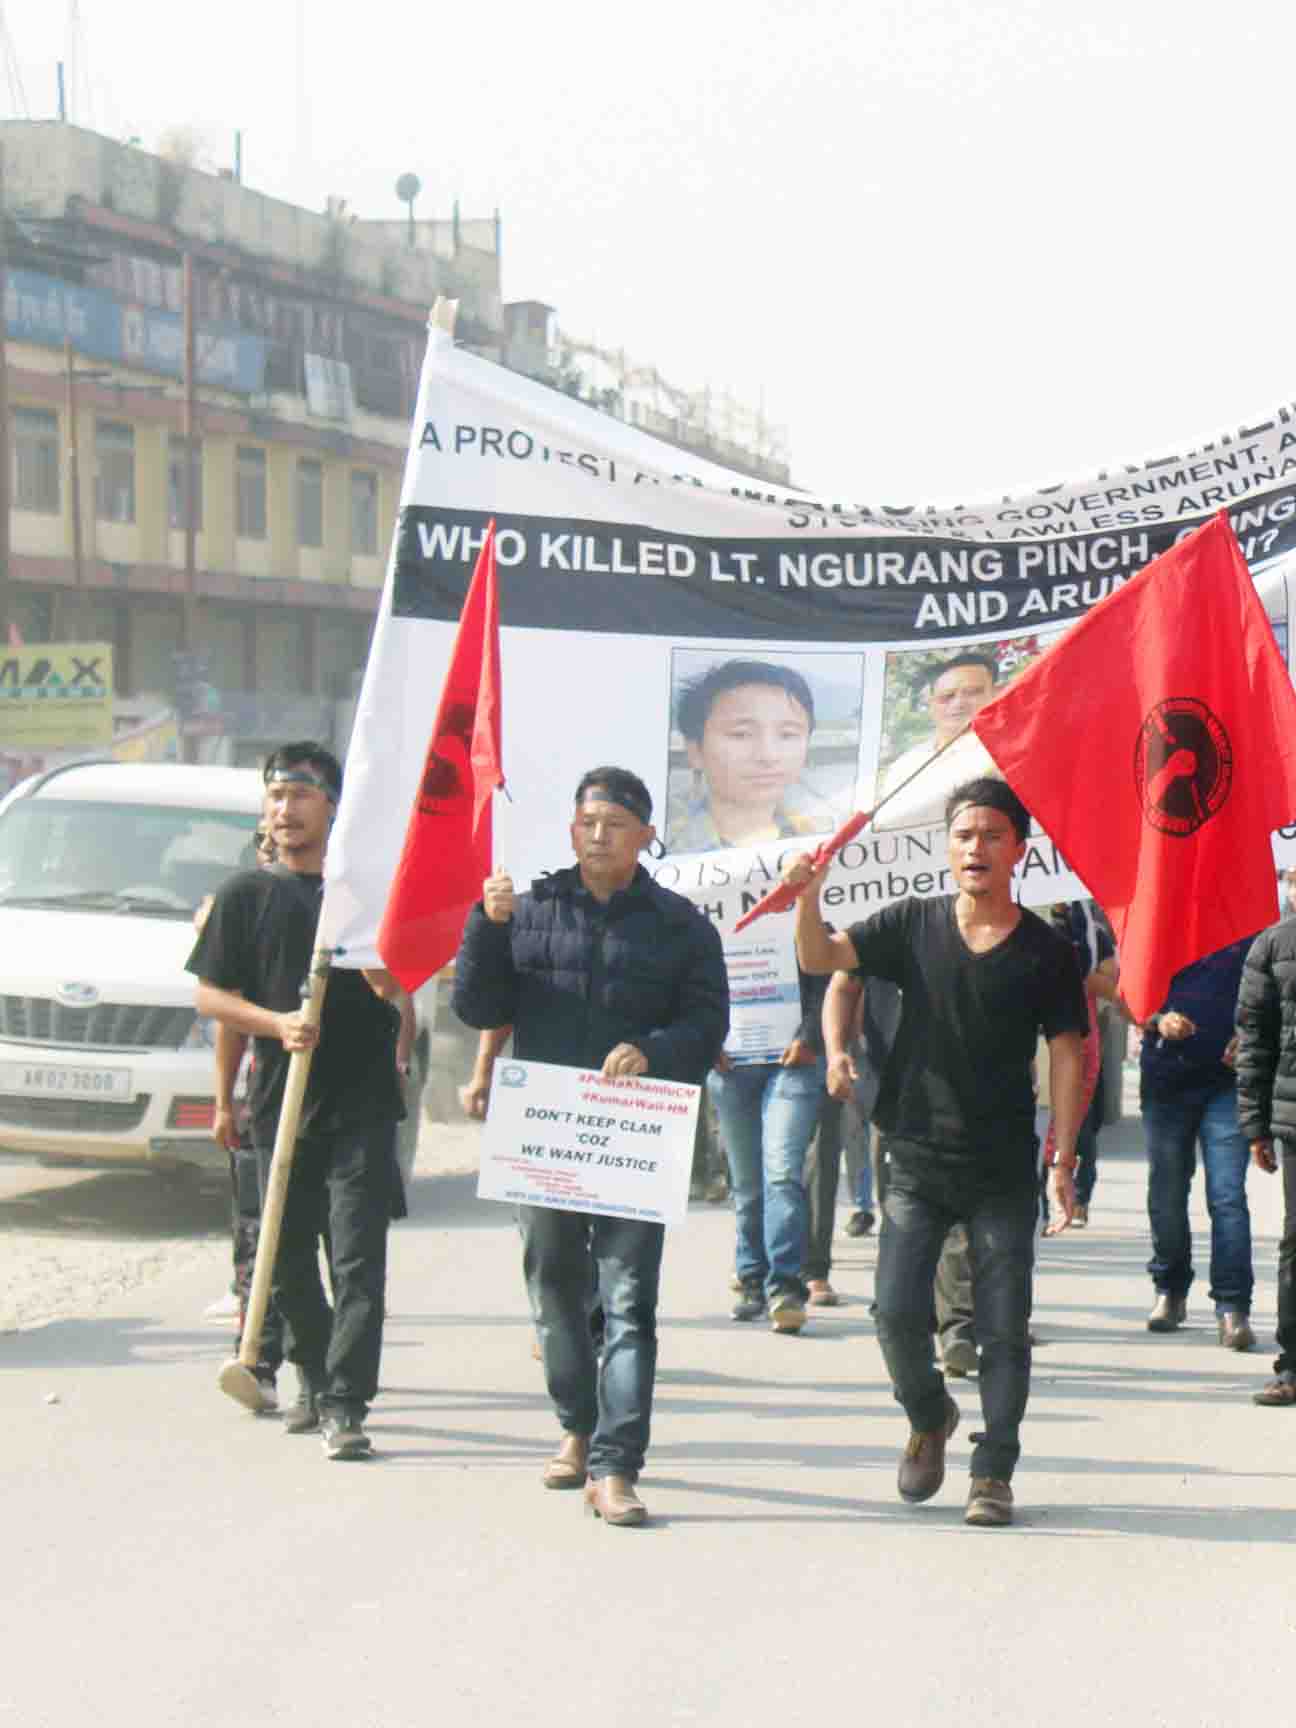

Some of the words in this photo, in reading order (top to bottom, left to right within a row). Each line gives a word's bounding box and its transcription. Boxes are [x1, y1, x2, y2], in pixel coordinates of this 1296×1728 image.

[419, 421, 442, 452] A
[416, 521, 527, 567] WHO
[539, 532, 697, 577] KILLED
[710, 550, 766, 585] LT.
[778, 547, 1002, 588] NGURANG
[1174, 495, 1296, 547] ING
[914, 588, 1009, 630] AND
[740, 867, 954, 915] Nember
[524, 1106, 573, 1123] DON'T
[575, 1112, 617, 1130] KEEP
[619, 1119, 663, 1137] CLAM
[521, 1143, 546, 1156] WE
[549, 1146, 594, 1164] WANT
[596, 1152, 658, 1173] JUSTICE
